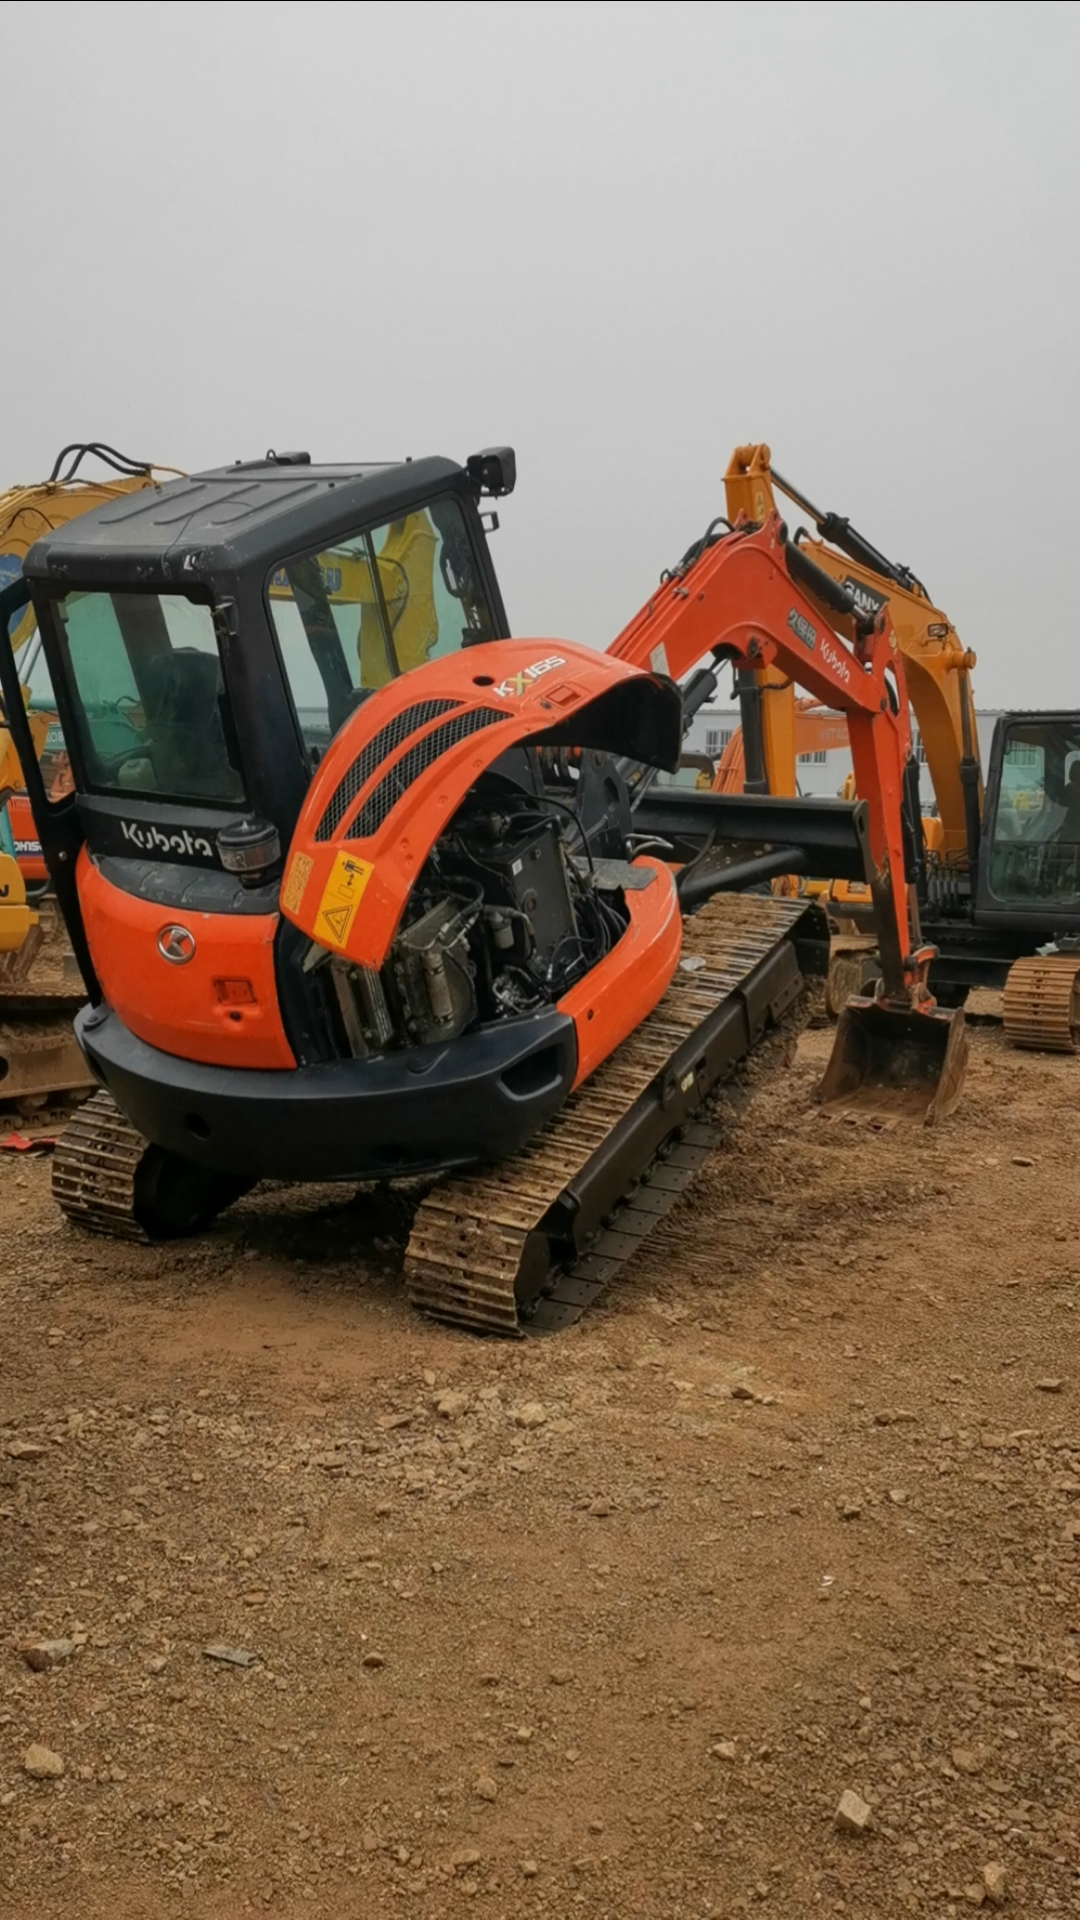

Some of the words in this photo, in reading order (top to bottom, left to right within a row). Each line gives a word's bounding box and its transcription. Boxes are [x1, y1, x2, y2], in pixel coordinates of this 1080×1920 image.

[492, 655, 567, 698] KX165
[820, 638, 850, 684] Kubota
[120, 820, 214, 857] Kubota
